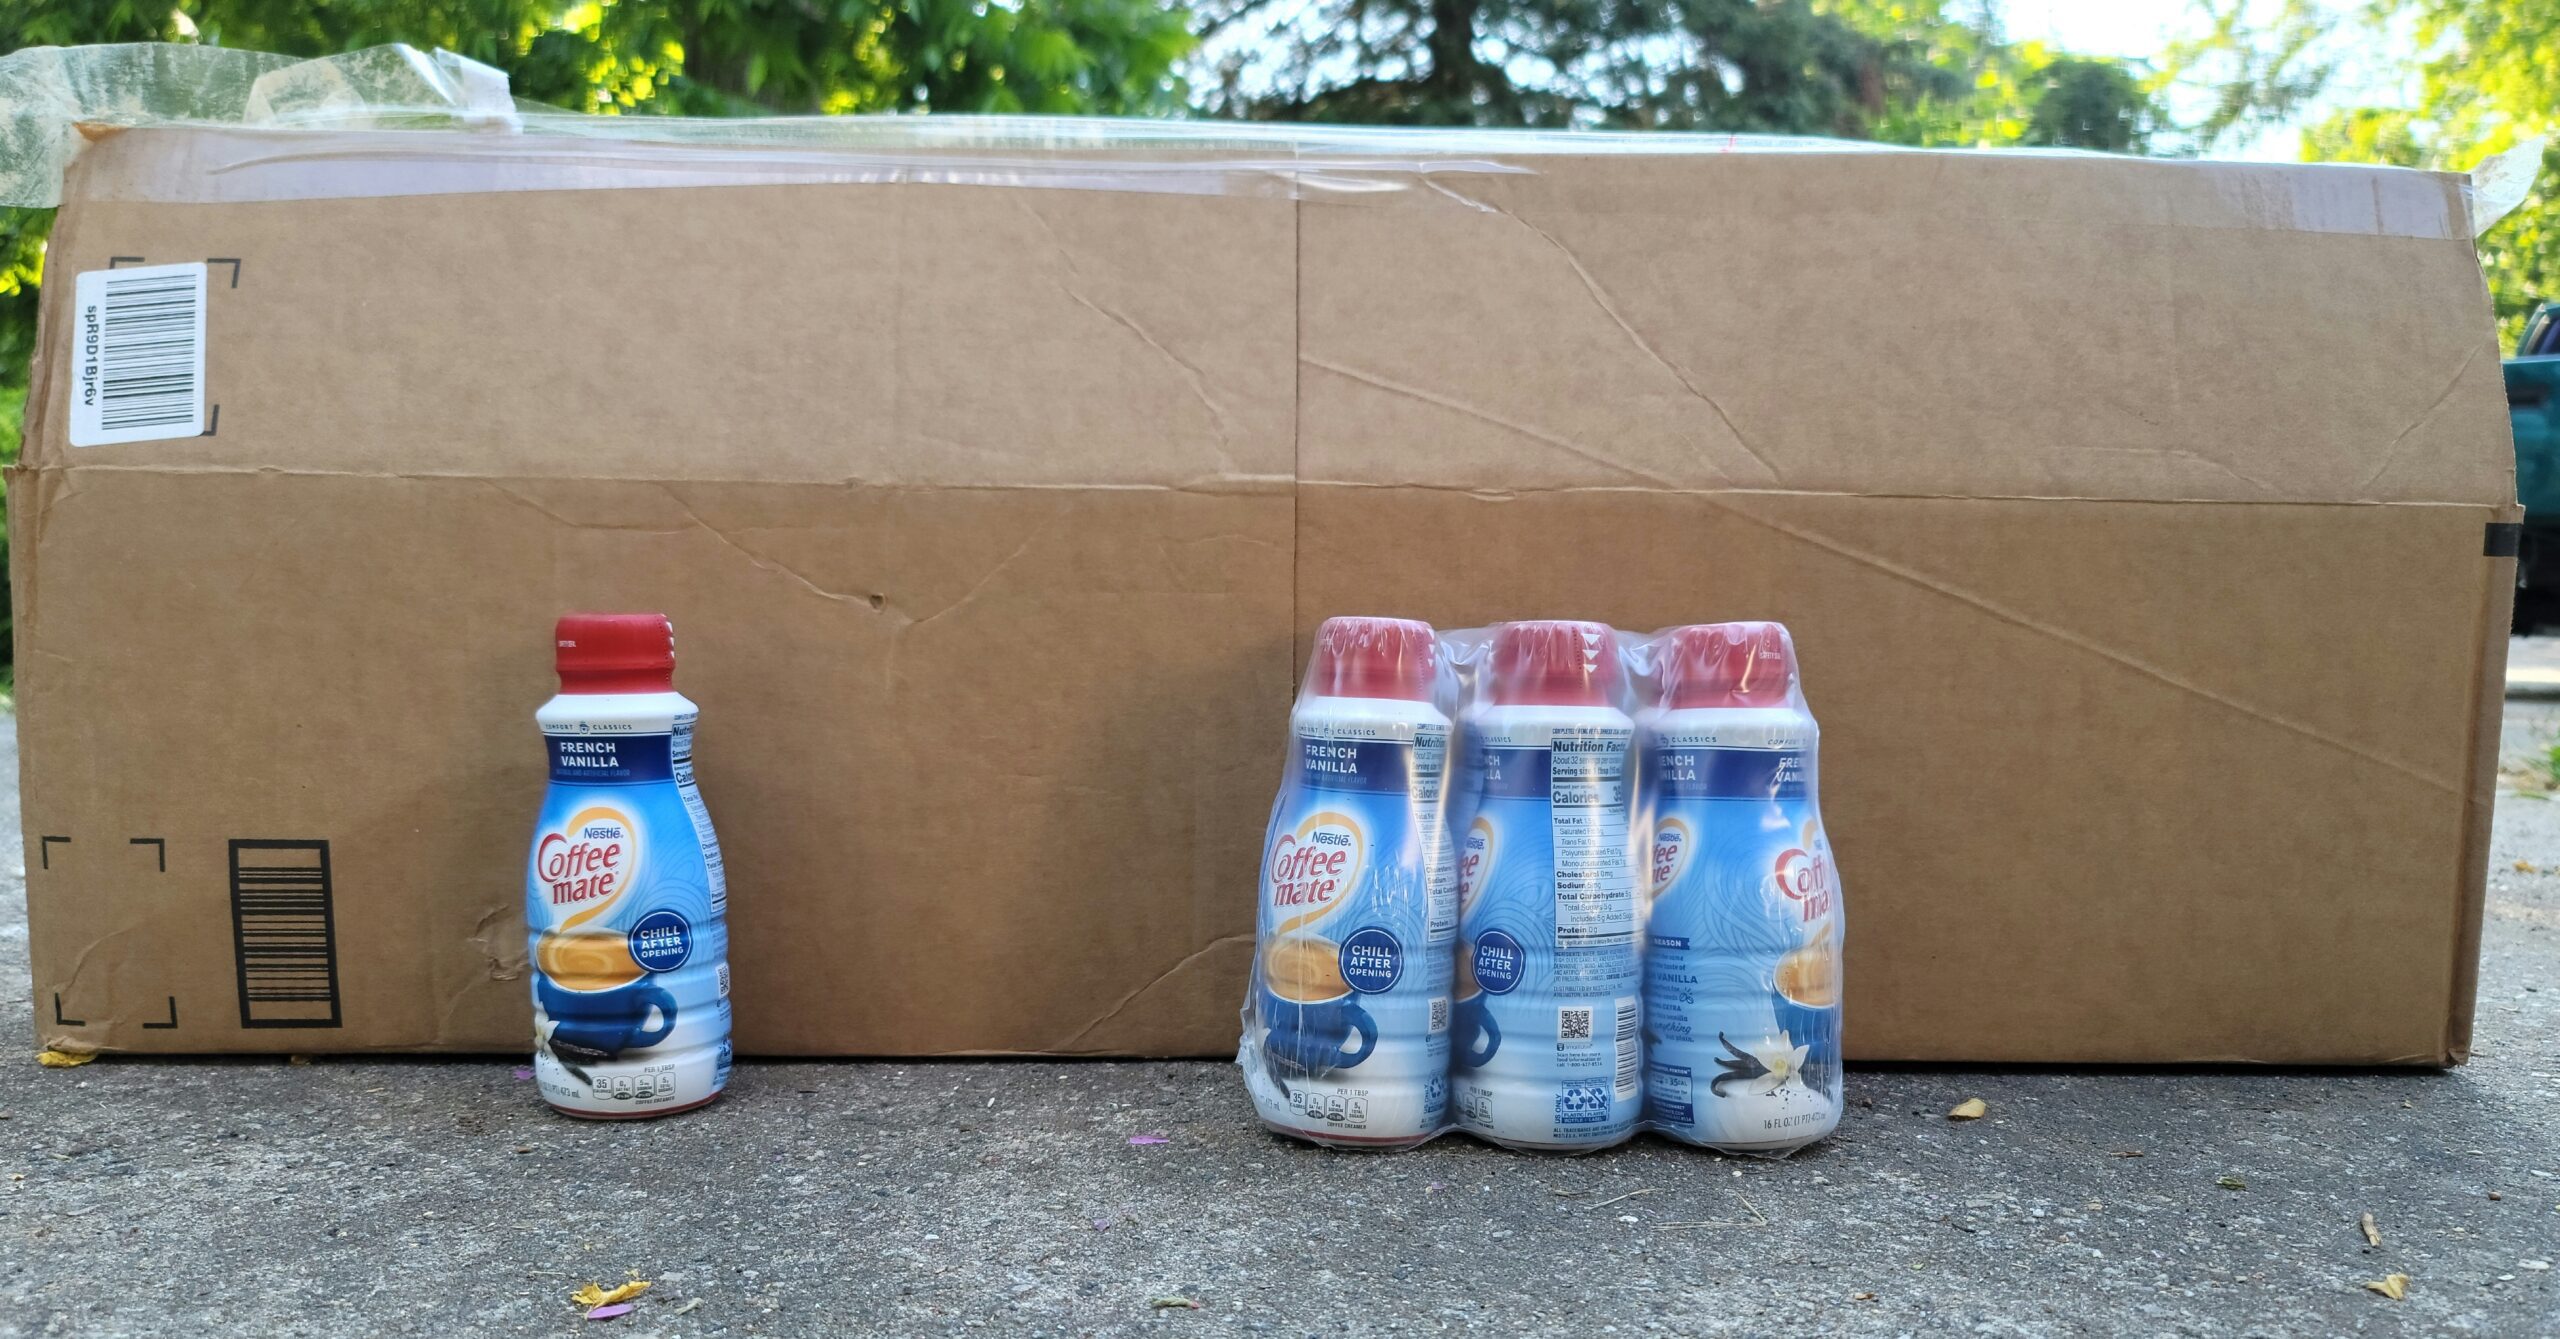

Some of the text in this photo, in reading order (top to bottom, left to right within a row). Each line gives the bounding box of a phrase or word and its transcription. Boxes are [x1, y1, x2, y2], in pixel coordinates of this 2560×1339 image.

[84, 305, 99, 406] spR9D1Bjr6v
[546, 723, 632, 731] COMFORT CLASSICS
[560, 742, 616, 753] FRENCH
[1305, 744, 1357, 758] FRENCH
[1553, 740, 1604, 753] Nutrition
[561, 756, 619, 767] VANILLA
[1305, 758, 1358, 774] VANILLA
[1553, 756, 1570, 764] About
[1571, 756, 1578, 764] 32
[1553, 766, 1578, 776] Serving
[1552, 791, 1600, 804] Calories
[1553, 817, 1583, 825] Total Fat
[584, 827, 622, 839] Nestlé
[1561, 838, 1577, 846] Trans
[537, 833, 621, 883] Coffee
[1272, 834, 1347, 884] Coffee
[1556, 870, 1600, 878] Cholesterol
[552, 871, 616, 905] mate
[1273, 878, 1335, 908] mate
[1570, 915, 1597, 923] Includes
[640, 926, 681, 939] CHILL
[1557, 926, 1587, 934] Protein
[641, 936, 682, 949] AFTER
[641, 947, 684, 958] OPENING
[1351, 945, 1392, 958] CHILL
[1480, 945, 1514, 960] CHILL
[1350, 956, 1392, 969] AFTER
[1478, 958, 1512, 971] AFTER
[1349, 967, 1392, 979] OPENING
[1477, 968, 1512, 980] OPENING
[1657, 973, 1698, 984] VANILLA
[596, 1079, 607, 1089] 35
[1293, 1092, 1303, 1104] 35
[1555, 1114, 1561, 1123] US
[1764, 1120, 1772, 1129] 16
[1774, 1118, 1782, 1128] FL
